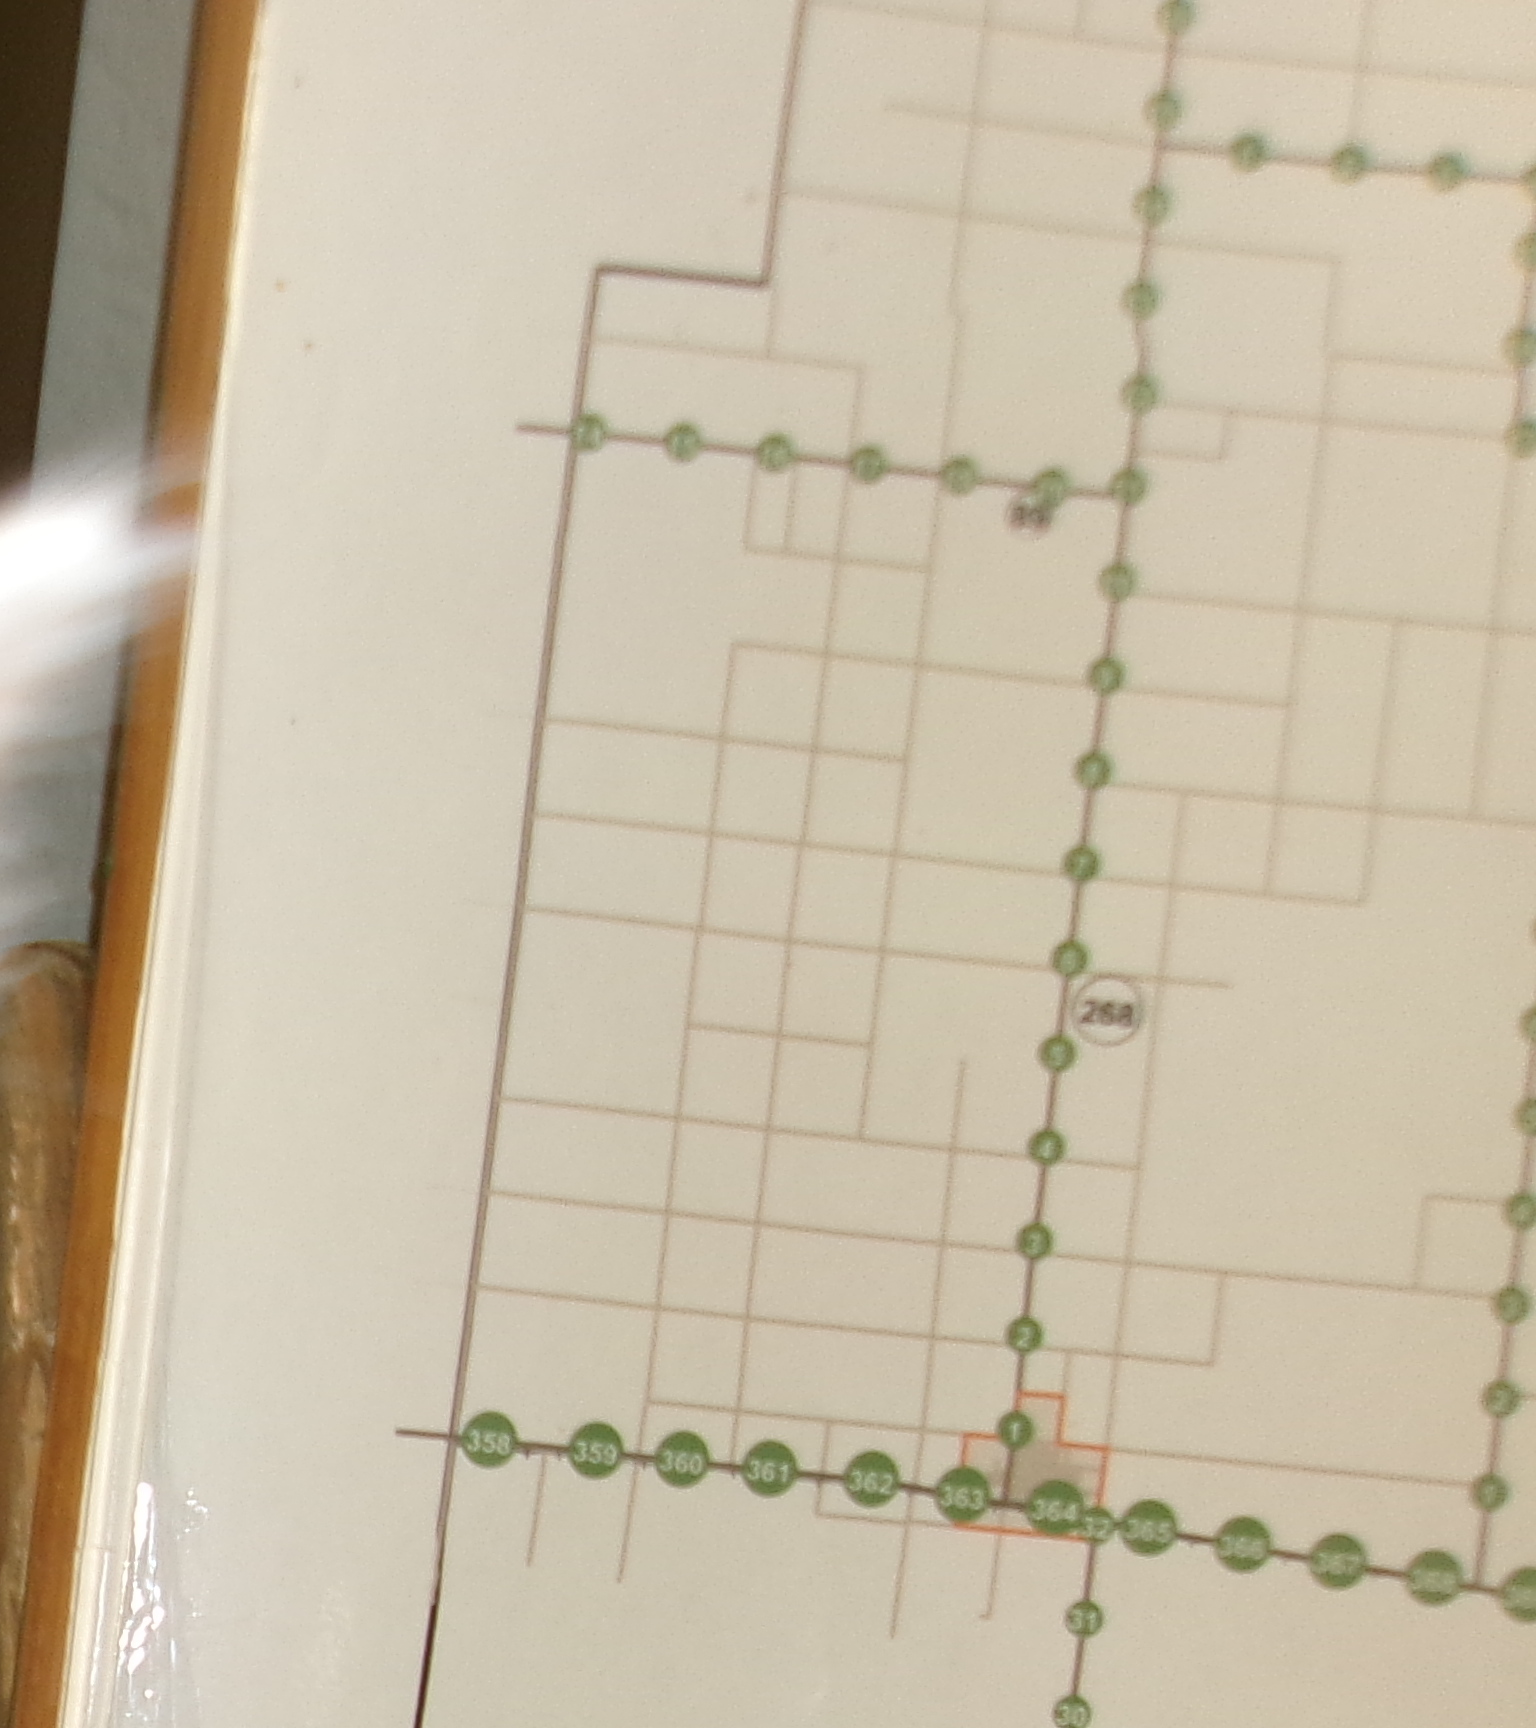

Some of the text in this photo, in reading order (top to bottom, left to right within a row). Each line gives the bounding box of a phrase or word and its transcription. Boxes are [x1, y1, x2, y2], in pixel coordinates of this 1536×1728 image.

[1080, 1000, 1132, 1026] 268
[466, 1428, 512, 1455] 358
[573, 1441, 617, 1465] 359
[659, 1450, 703, 1474] 360
[747, 1460, 790, 1482] 361
[849, 1470, 893, 1494] 362
[939, 1485, 985, 1510] 363
[1034, 1499, 1076, 1522] 364
[1071, 1609, 1098, 1630] 31
[1057, 1705, 1085, 1724] 30
